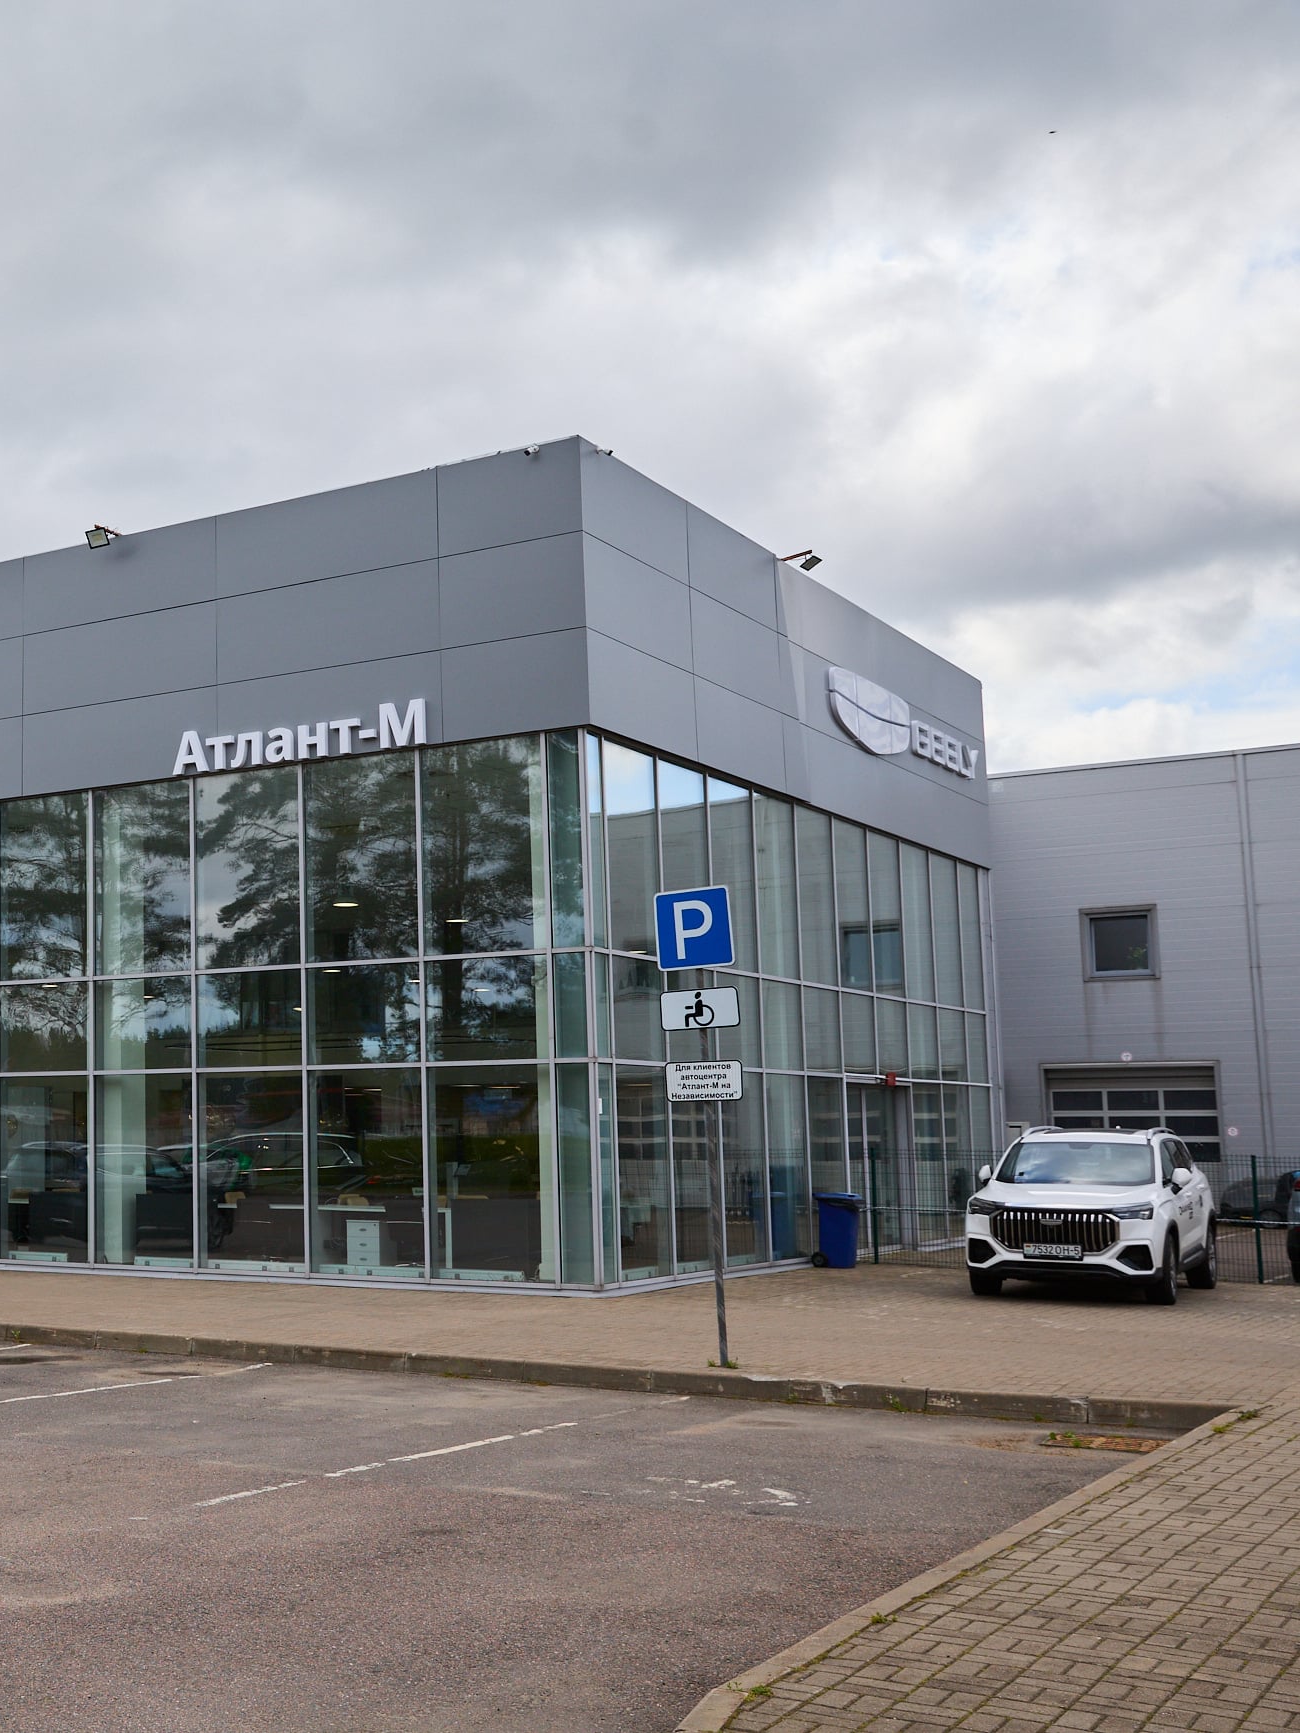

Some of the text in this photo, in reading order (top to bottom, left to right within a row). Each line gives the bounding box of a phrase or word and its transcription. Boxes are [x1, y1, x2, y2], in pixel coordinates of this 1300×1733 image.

[172, 698, 428, 776] Атлант-М
[911, 720, 979, 780] GEELY
[673, 900, 713, 960] P
[675, 1063, 731, 1072] Для клиентов
[680, 1073, 727, 1081] автоцентра
